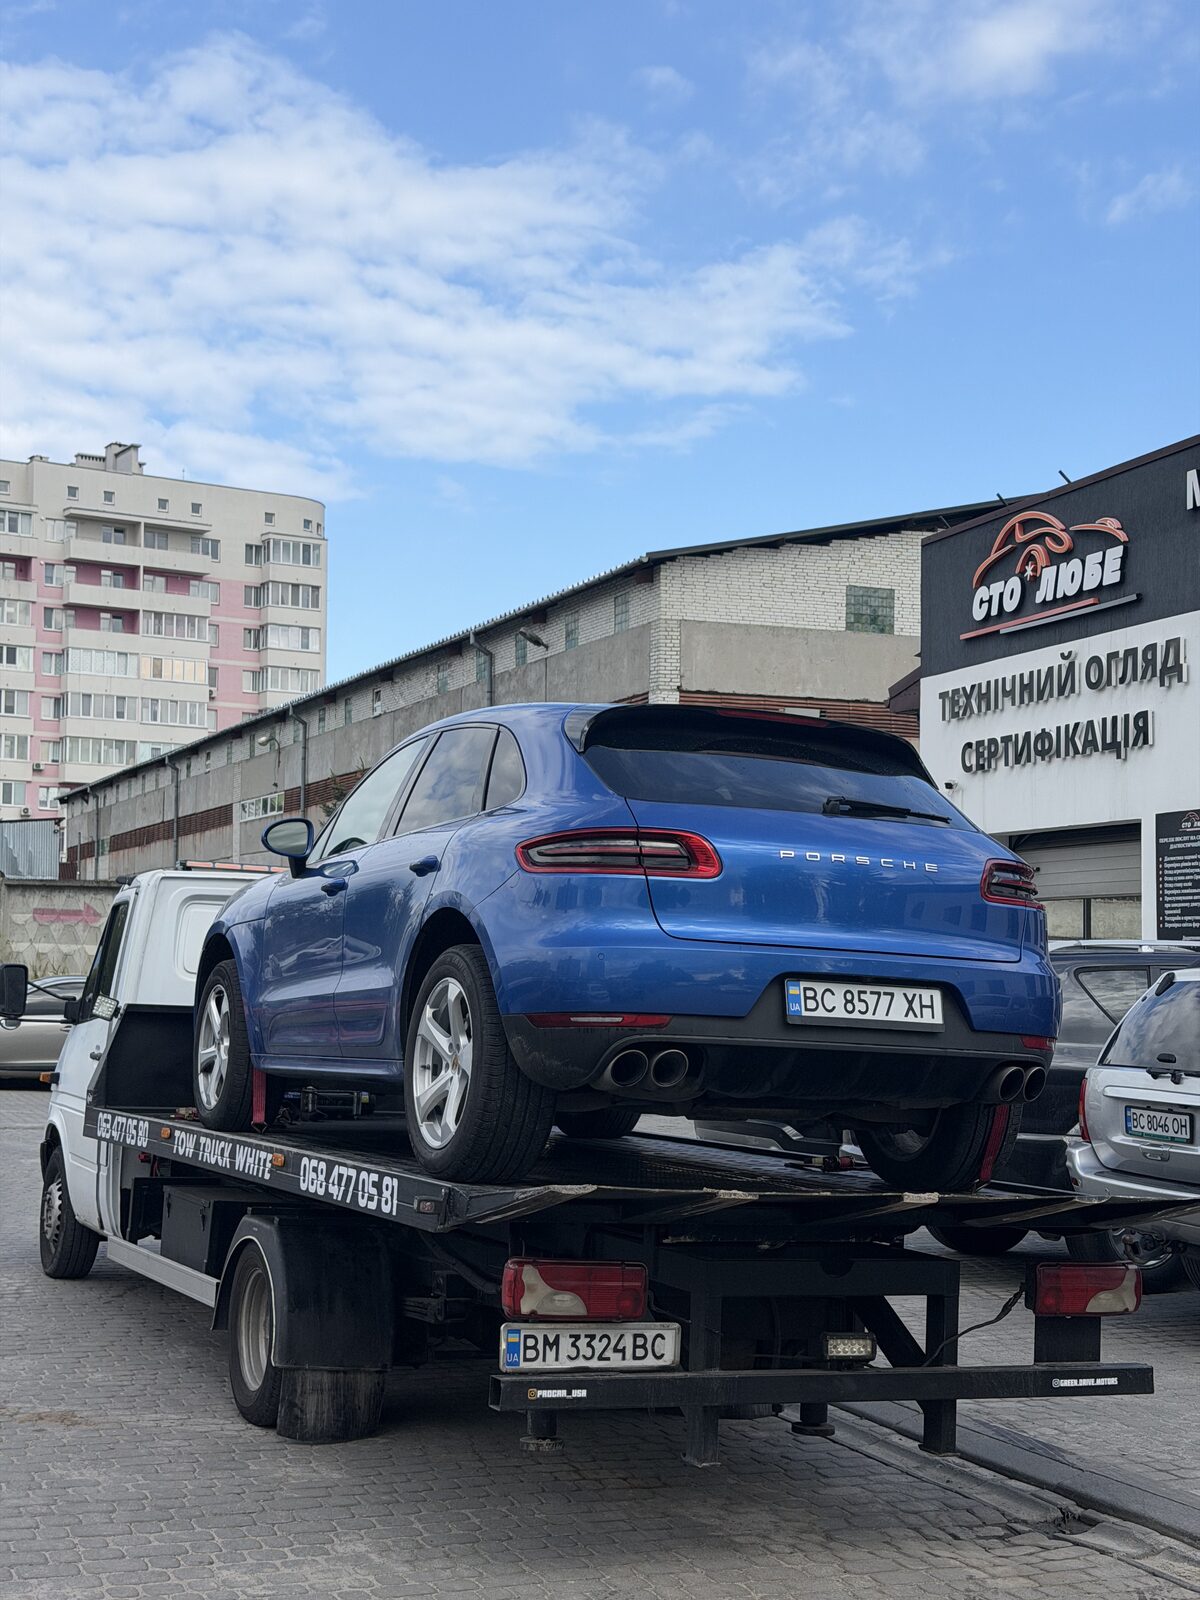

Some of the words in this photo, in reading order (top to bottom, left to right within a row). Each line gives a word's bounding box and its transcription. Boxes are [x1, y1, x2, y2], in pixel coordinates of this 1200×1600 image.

[972, 576, 1022, 622] СТО
[1035, 545, 1125, 604] ЛЮБЕ
[938, 650, 1078, 722] ТЕХНІЧНИЙ
[1084, 636, 1188, 690] ОГЛЯД
[960, 709, 1153, 774] СЕРТИФІКАЦІЯ
[779, 850, 939, 873] PORSCHE
[790, 1002, 800, 1012] UA
[803, 986, 836, 1013] BC
[843, 989, 895, 1017] 8577
[902, 992, 935, 1019] XH
[1132, 1111, 1146, 1130] BC
[1147, 1114, 1170, 1133] 8046
[1172, 1117, 1188, 1136] OH
[173, 1130, 198, 1158] TOW
[198, 1136, 233, 1169] TRUCK
[235, 1144, 273, 1180] WHITE
[506, 1353, 519, 1363] UA
[522, 1333, 560, 1363] BM
[566, 1333, 626, 1362] 3324
[632, 1332, 666, 1361] BC
